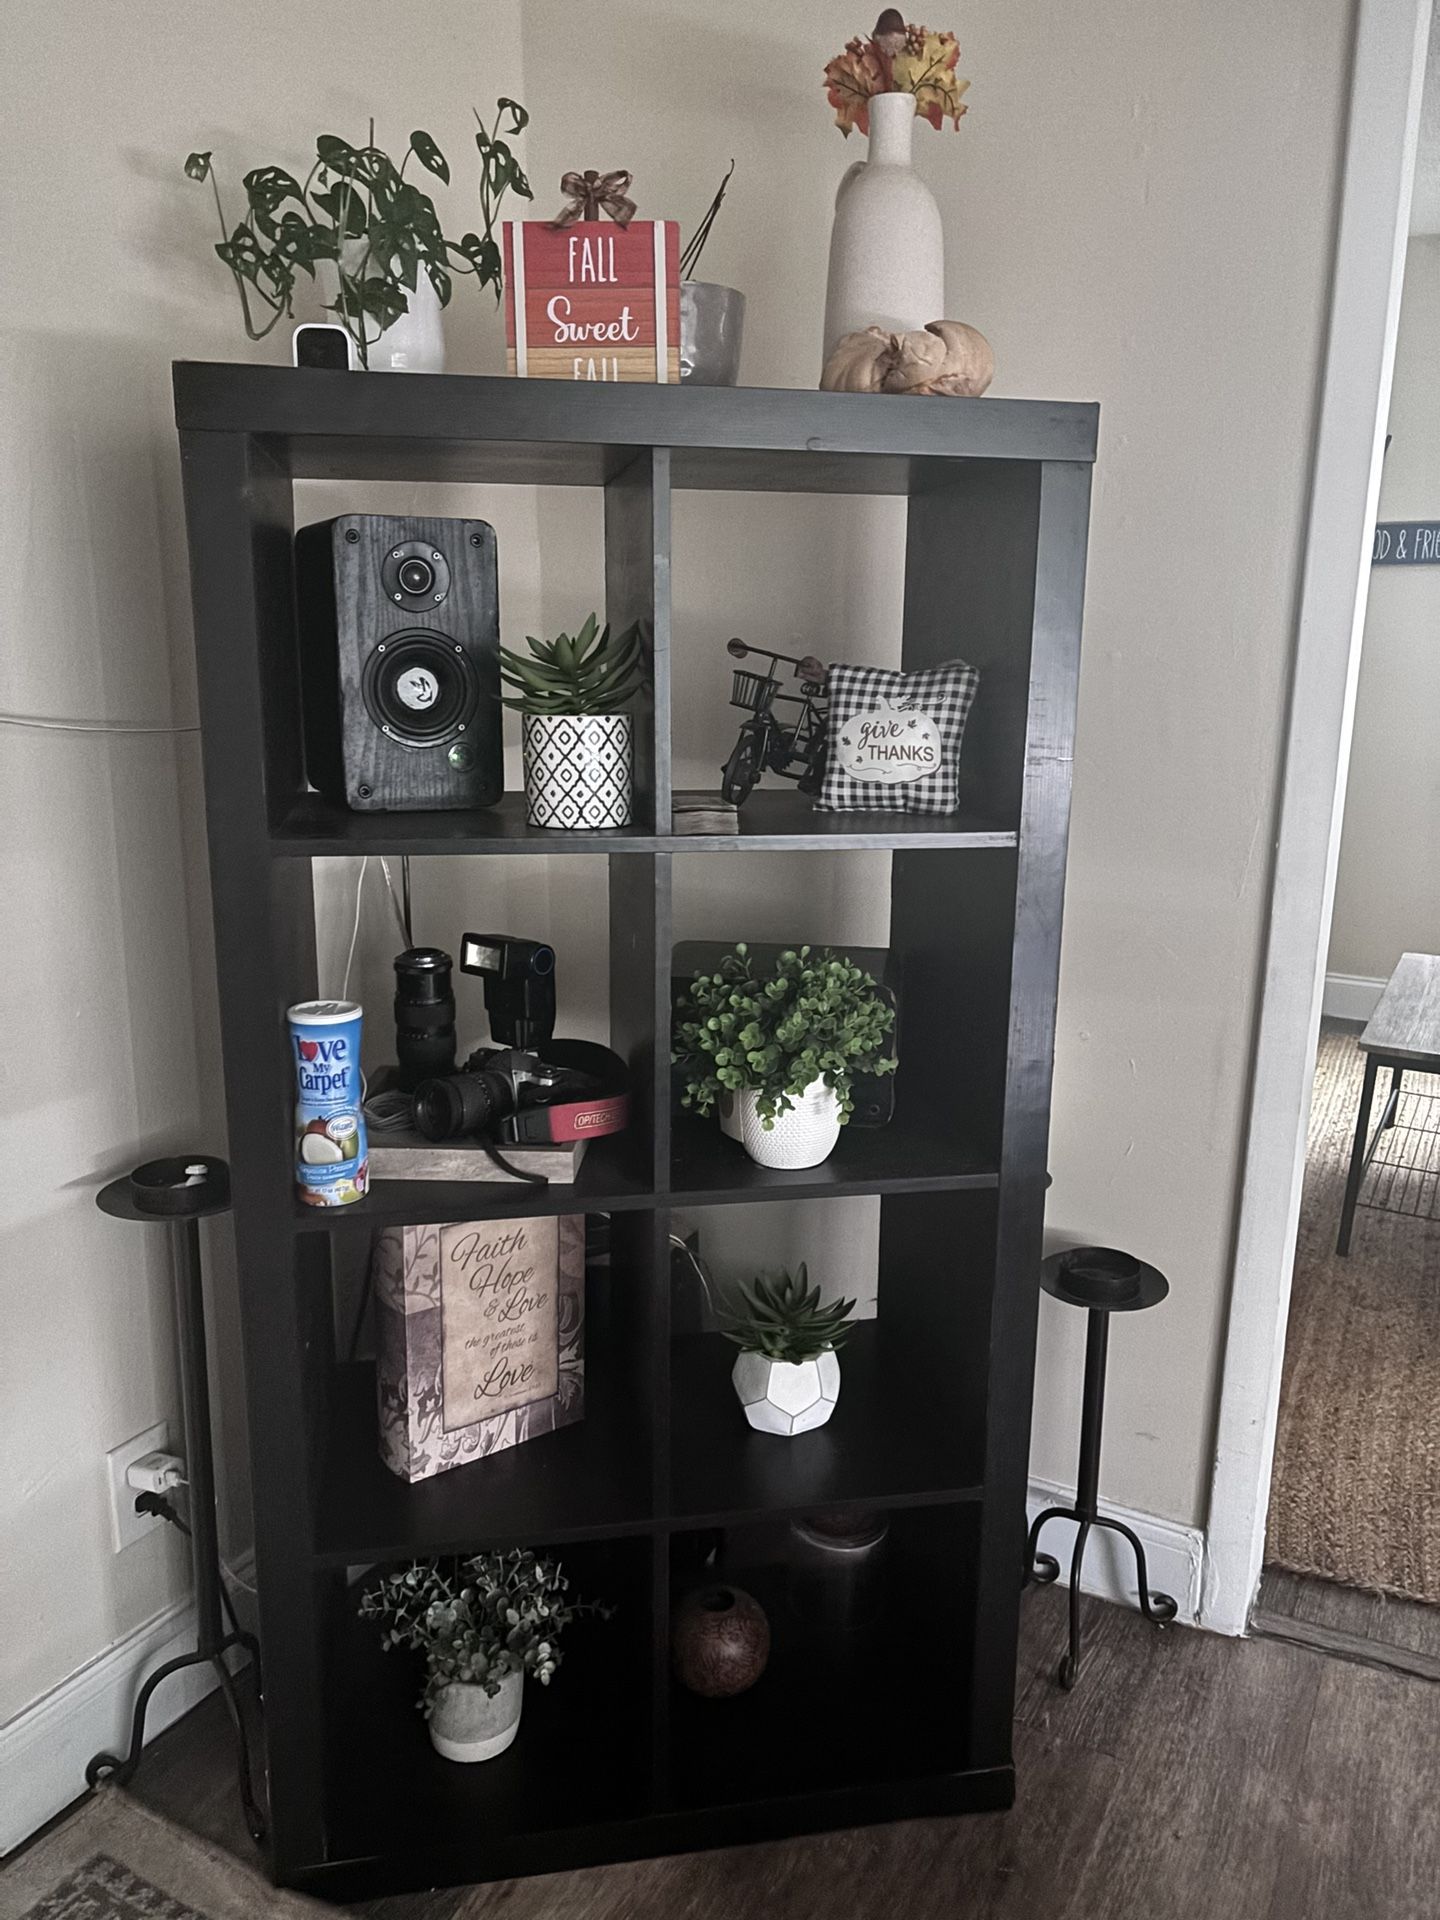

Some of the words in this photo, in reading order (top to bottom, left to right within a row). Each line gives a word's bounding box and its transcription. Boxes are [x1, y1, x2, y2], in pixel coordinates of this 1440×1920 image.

[569, 236, 618, 282] FALL
[547, 295, 640, 343] Sweet
[1396, 530, 1407, 559] &
[857, 720, 904, 750] give
[867, 744, 934, 762] THANKS
[299, 1066, 348, 1095] Carpet
[313, 1062, 331, 1074] My
[450, 1227, 528, 1271] Faith
[469, 1256, 535, 1298] Hope
[484, 1298, 499, 1317] &
[498, 1287, 549, 1323] Love
[465, 1336, 481, 1350] the
[482, 1323, 525, 1348] greatest
[490, 1342, 502, 1359] of
[528, 1332, 538, 1344] is
[473, 1356, 536, 1400] Love
